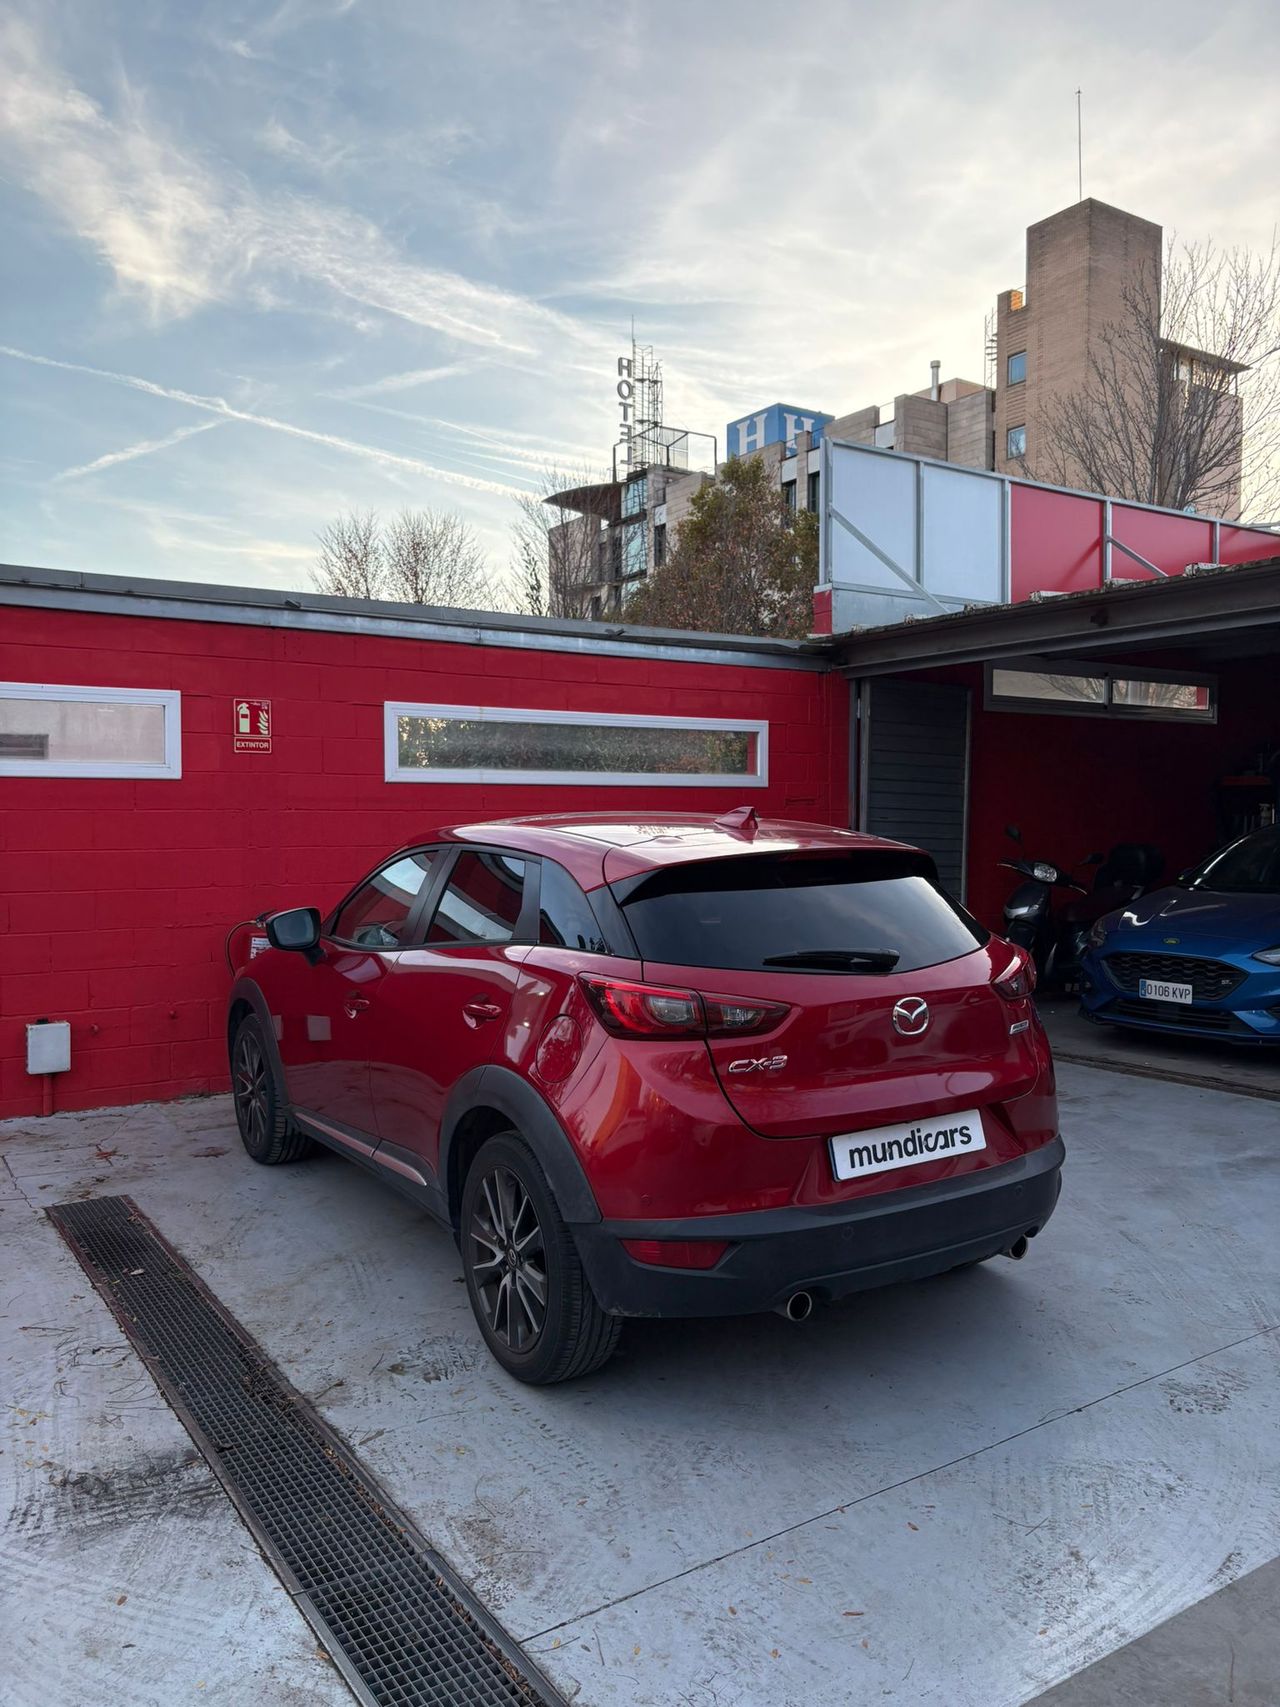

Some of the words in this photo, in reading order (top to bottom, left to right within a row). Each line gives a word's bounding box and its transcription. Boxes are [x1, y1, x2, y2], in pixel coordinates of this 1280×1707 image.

[736, 413, 768, 455] H
[237, 741, 269, 749] EXTINTOR
[1147, 984, 1169, 997] 0106
[1172, 987, 1191, 1000] KVP
[729, 1055, 787, 1072] CX-3
[849, 1125, 972, 1168] mundicars
